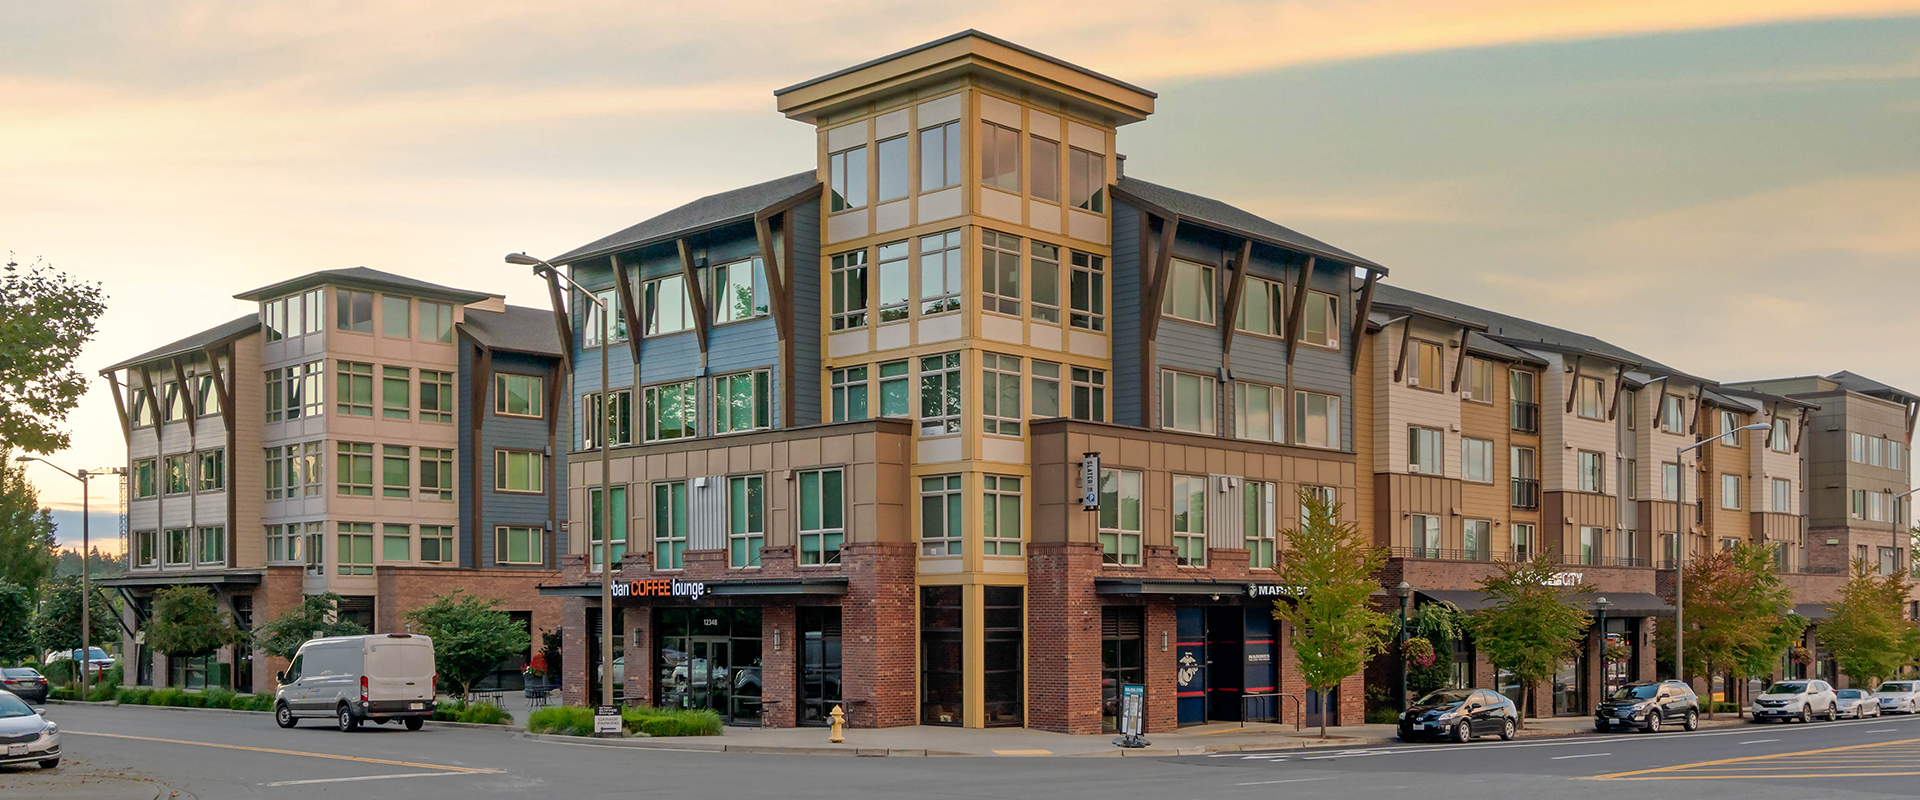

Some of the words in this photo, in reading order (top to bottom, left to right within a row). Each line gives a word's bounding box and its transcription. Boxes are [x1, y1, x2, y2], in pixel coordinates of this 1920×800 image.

[610, 579, 630, 597] ban
[630, 579, 671, 597] COFFEE
[672, 578, 704, 600] lounge
